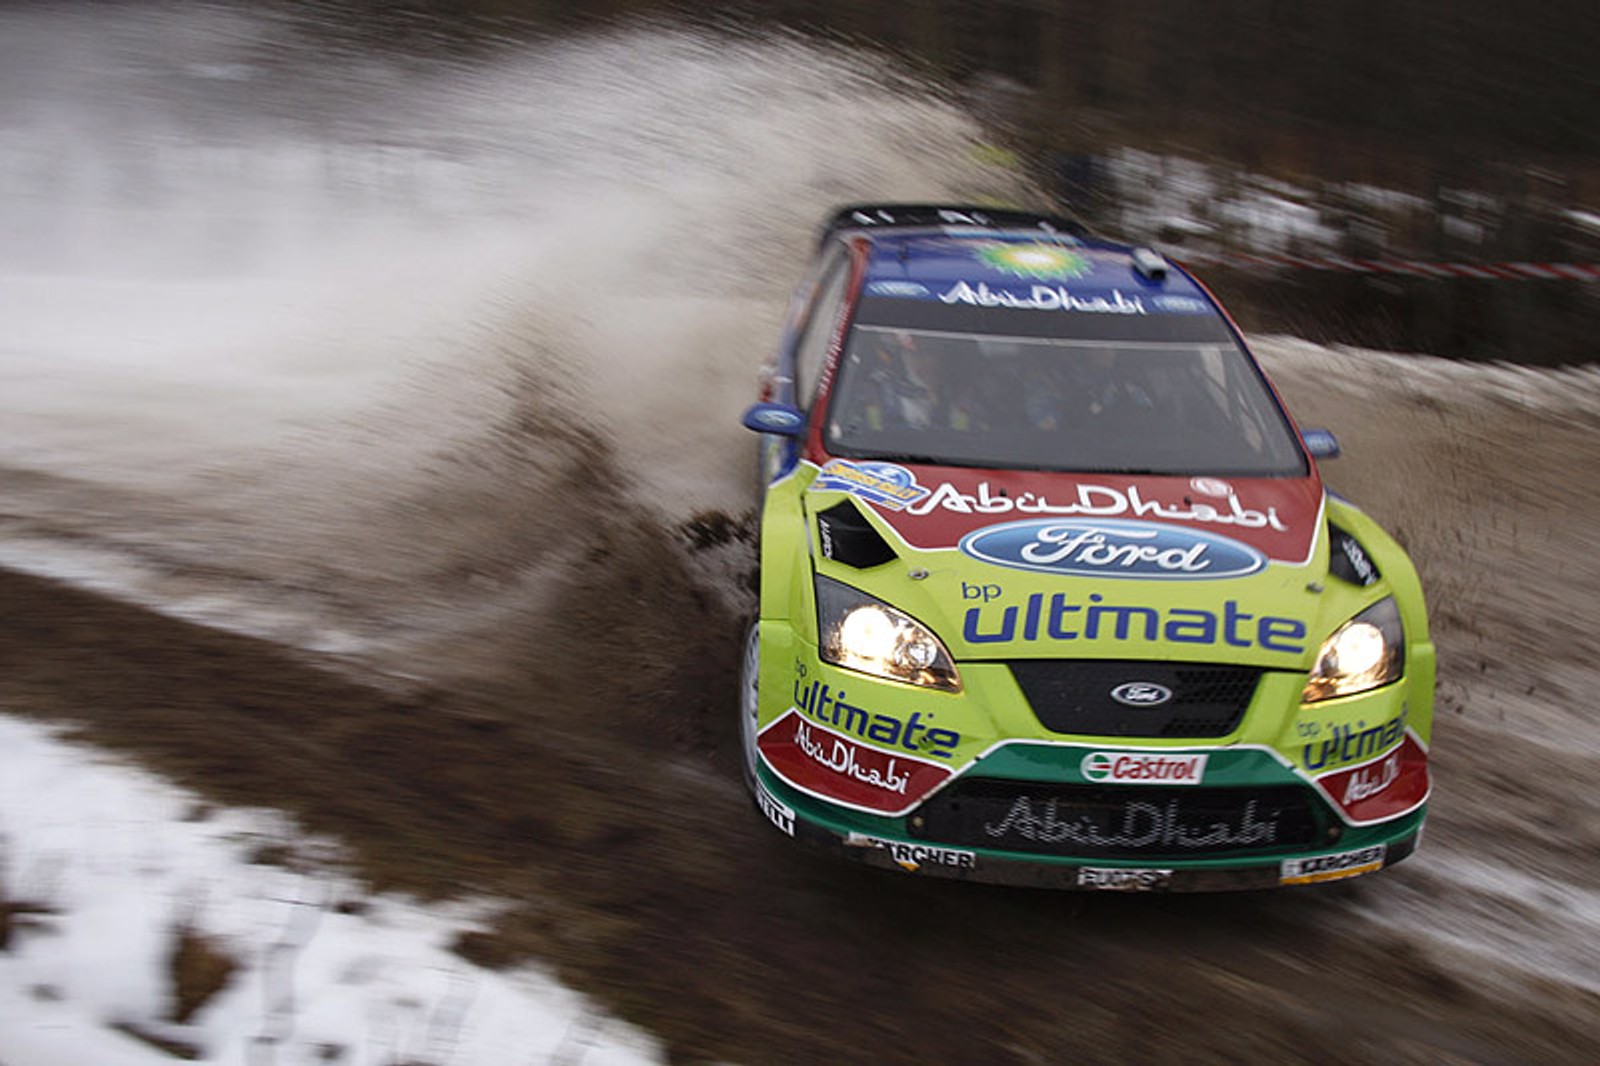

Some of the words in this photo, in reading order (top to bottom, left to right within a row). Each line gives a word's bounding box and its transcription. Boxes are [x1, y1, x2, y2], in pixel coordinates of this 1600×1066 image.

[1020, 524, 1210, 573] Ford
[961, 581, 1002, 603] bp
[963, 592, 1307, 655] ultimate
[794, 678, 961, 759] ultimate
[1113, 755, 1198, 781] Castrol
